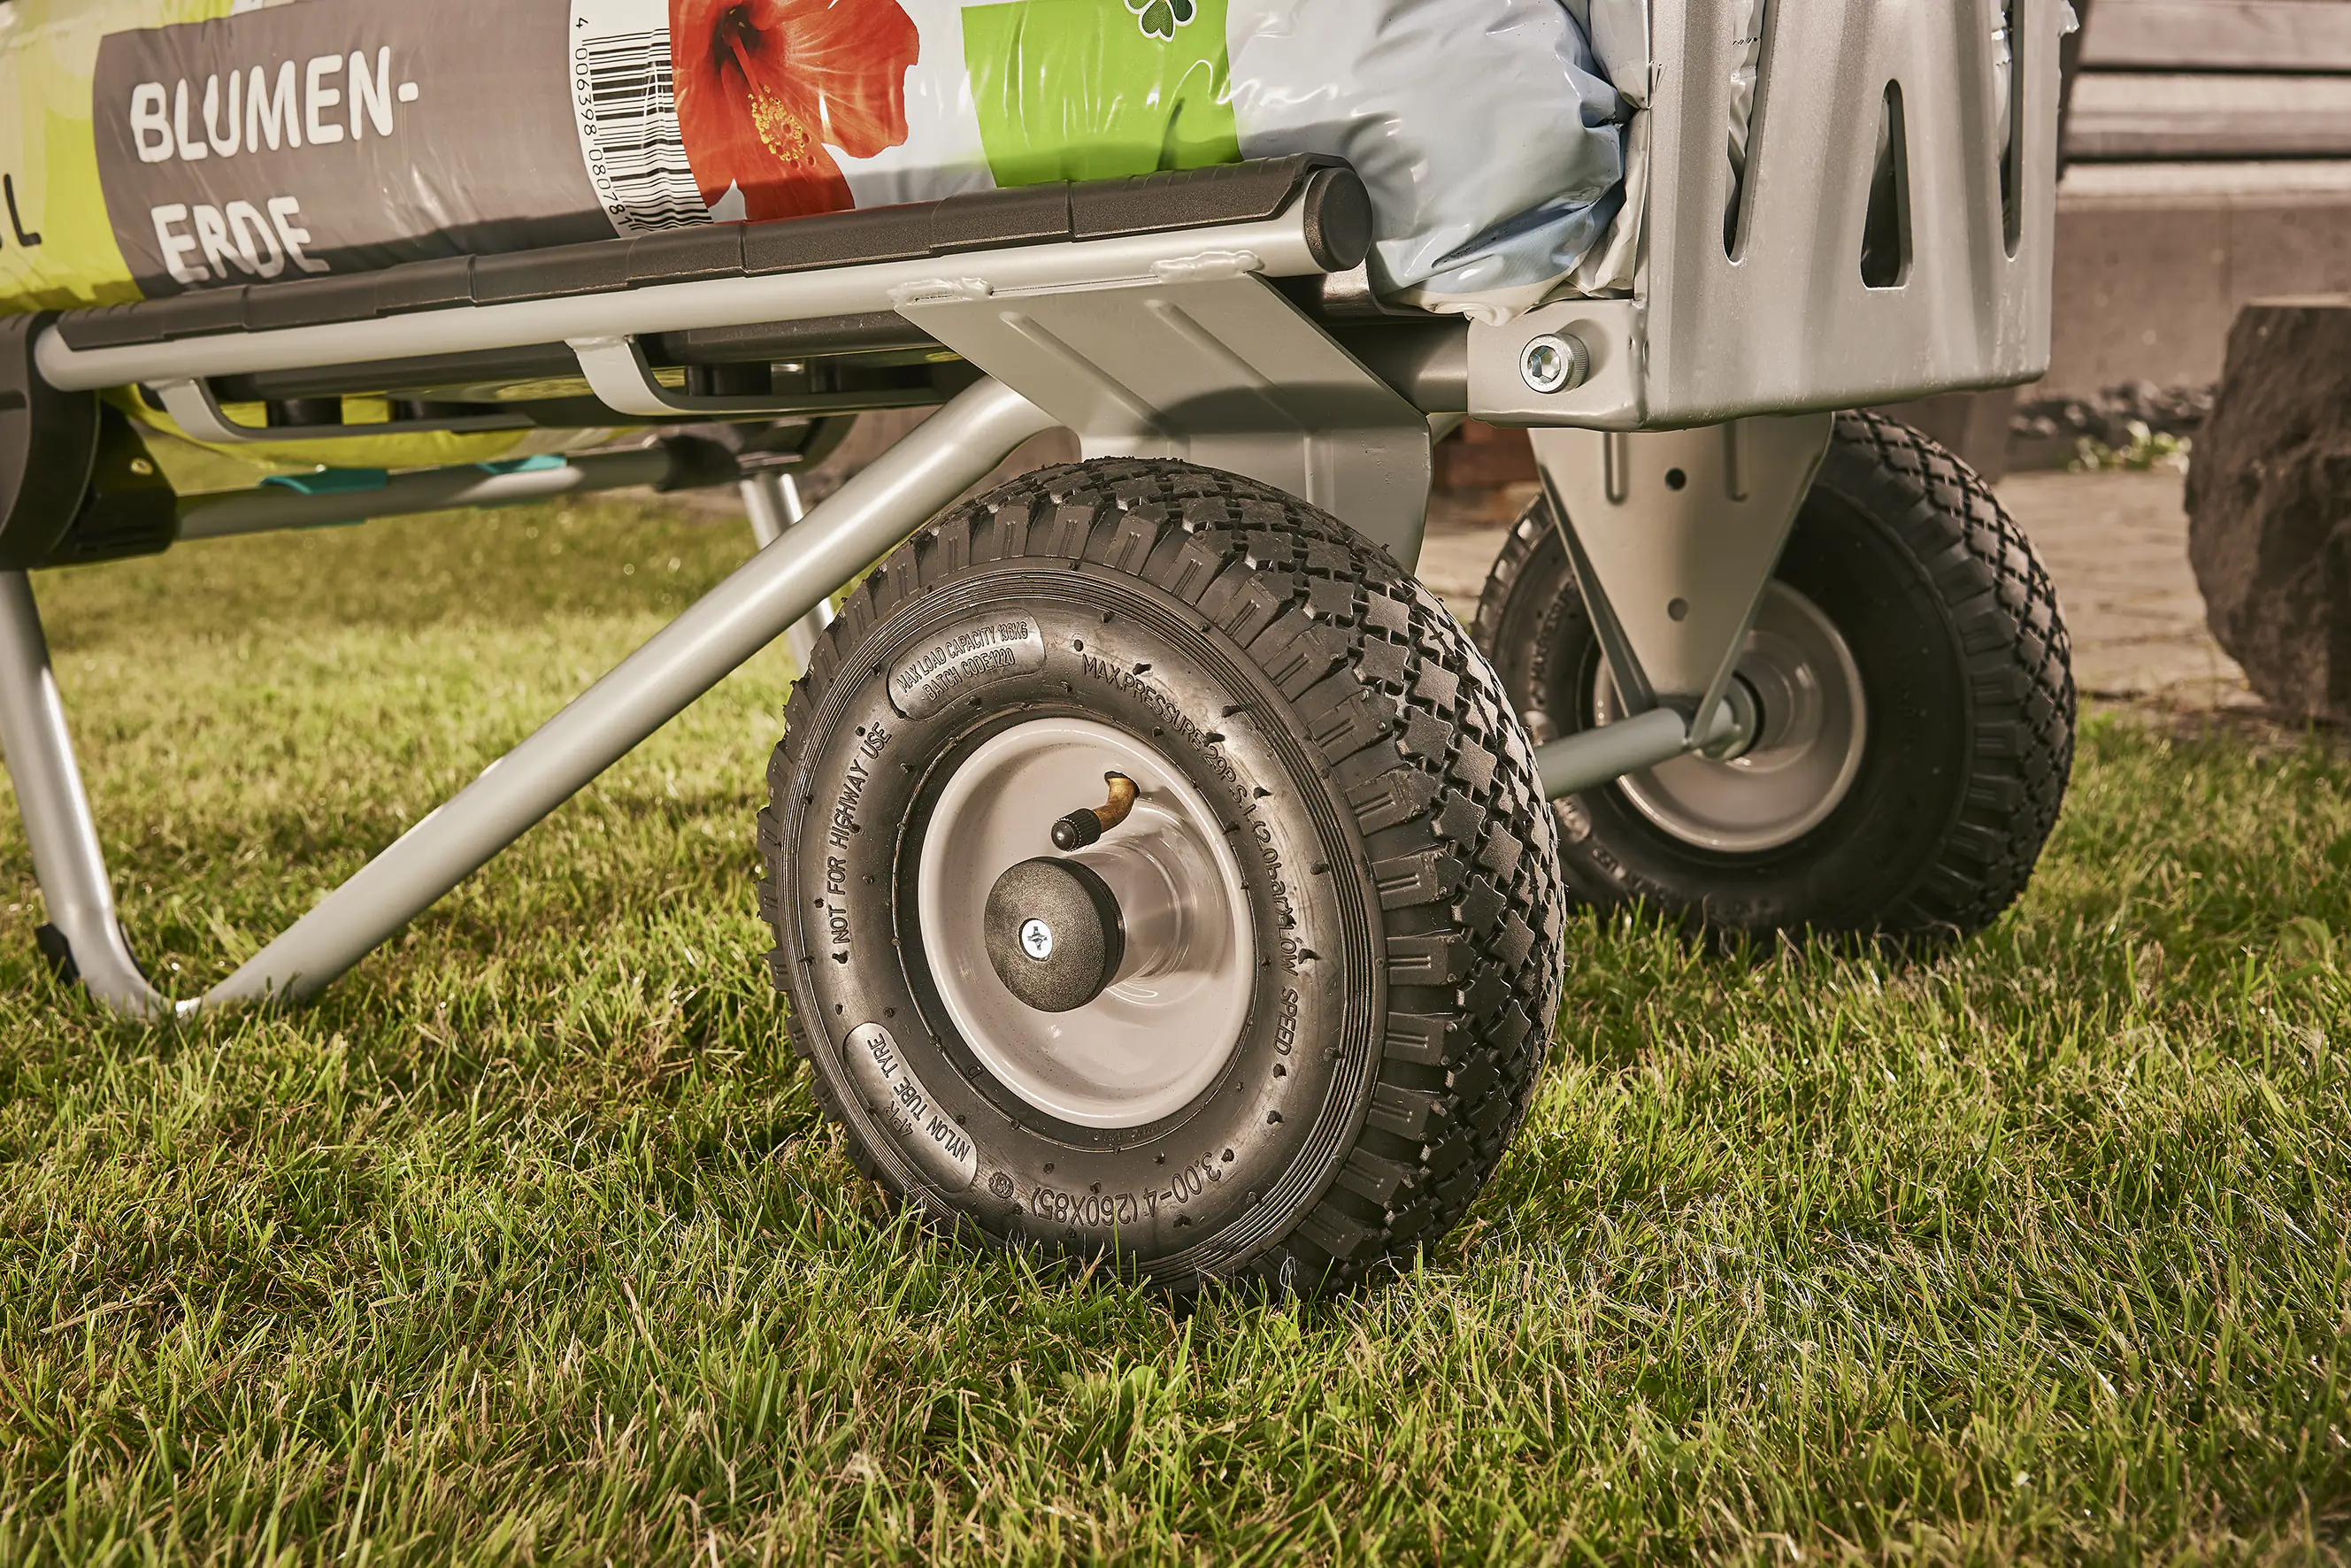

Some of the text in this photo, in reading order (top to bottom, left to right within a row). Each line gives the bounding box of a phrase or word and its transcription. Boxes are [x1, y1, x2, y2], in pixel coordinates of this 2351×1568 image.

[130, 46, 419, 163] BLUMEN-
[574, 17, 634, 227] 4 006398 080781
[151, 196, 331, 283] ERDE
[896, 664, 922, 694] MAX
[918, 647, 947, 677] LOAD
[945, 625, 996, 658] CAPACITY
[922, 665, 963, 702] BATCH
[1081, 655, 1206, 752] MAX.PRESSURE
[827, 721, 893, 946] NOT FOR HIGHWAY USE
[1277, 922, 1299, 978] LOW
[1272, 987, 1299, 1057] SPEED
[866, 1033, 971, 1163] NYLON TUBE TYRE
[1030, 1151, 1222, 1228] 3.00-4 (260X85)
